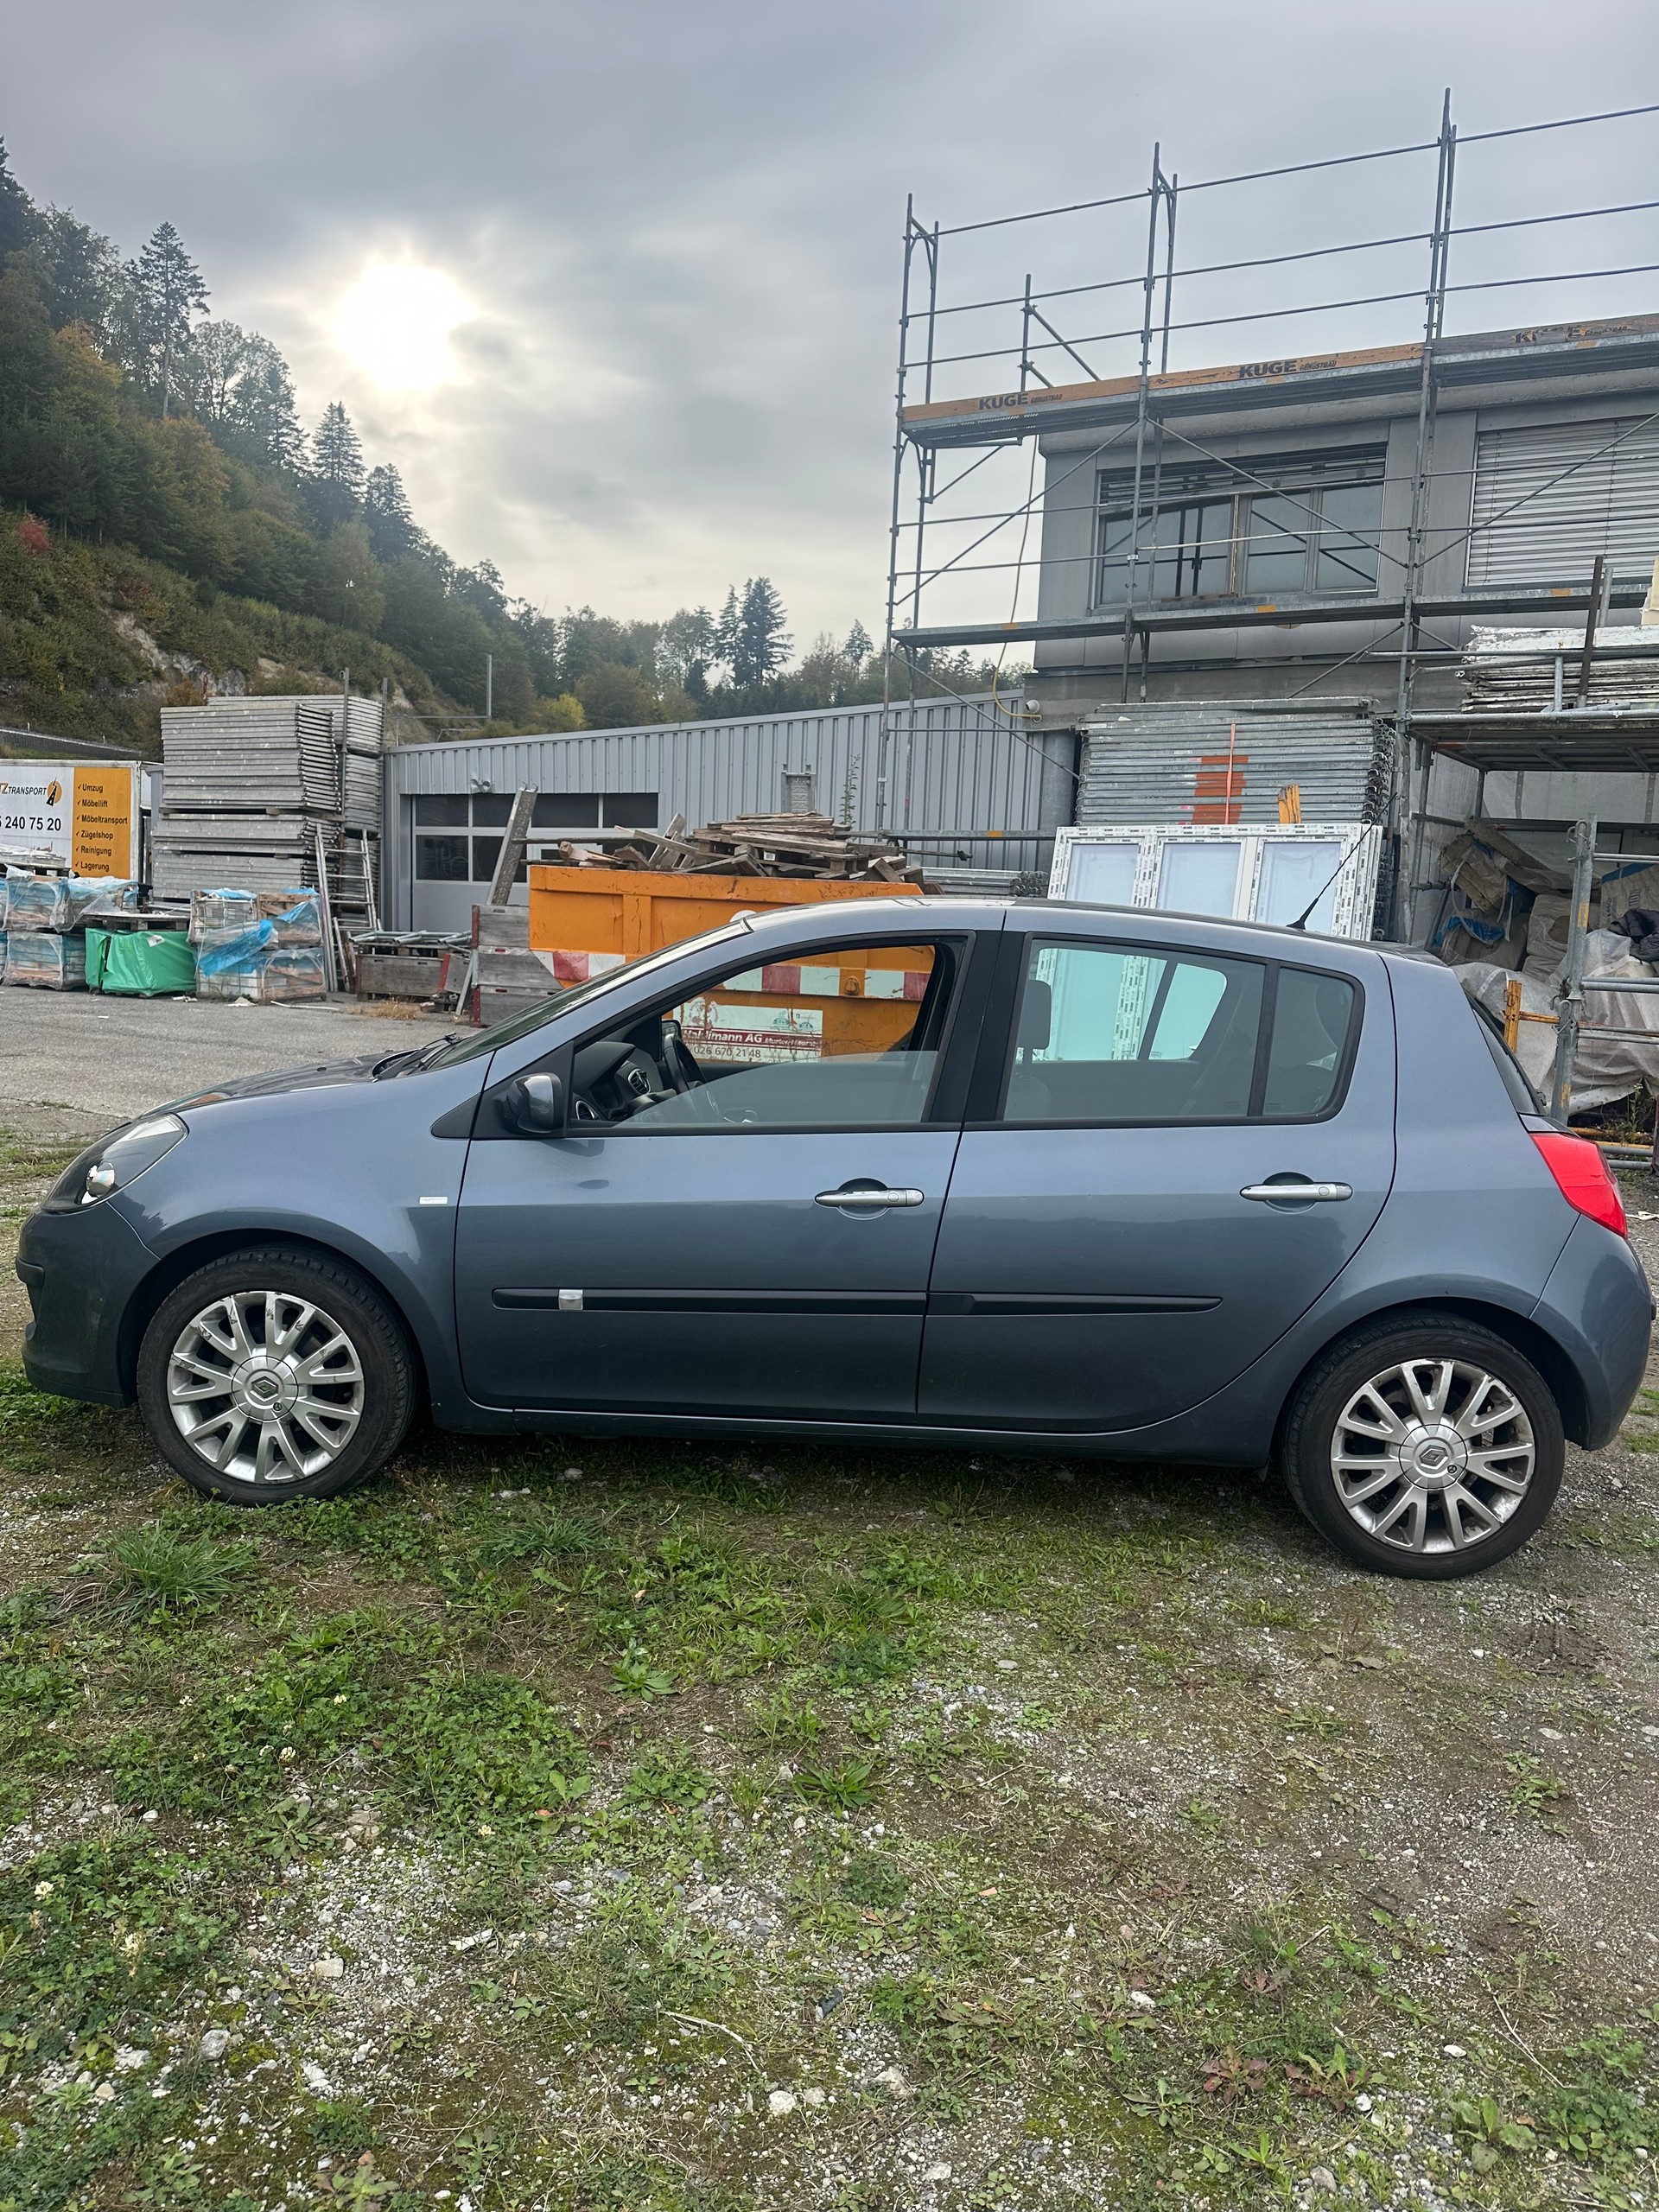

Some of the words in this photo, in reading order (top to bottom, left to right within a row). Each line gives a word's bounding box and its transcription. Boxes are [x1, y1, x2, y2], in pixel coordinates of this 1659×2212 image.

[1239, 359, 1297, 378] KUGE
[979, 392, 1028, 410] KUGE
[82, 784, 104, 793] Umzug
[82, 799, 108, 808] Möbellift
[5, 816, 25, 830] 240
[29, 817, 43, 830] 75
[47, 817, 61, 831] 20
[81, 815, 128, 825] Möbeltransport
[80, 830, 114, 841] Zügelshop
[80, 846, 112, 856] Reinigung
[80, 861, 110, 872] Lagerung
[745, 1033, 763, 1043] AG
[694, 1046, 712, 1055] 026
[715, 1047, 733, 1056] 670
[735, 1048, 747, 1057] 21
[748, 1049, 761, 1058] 48
